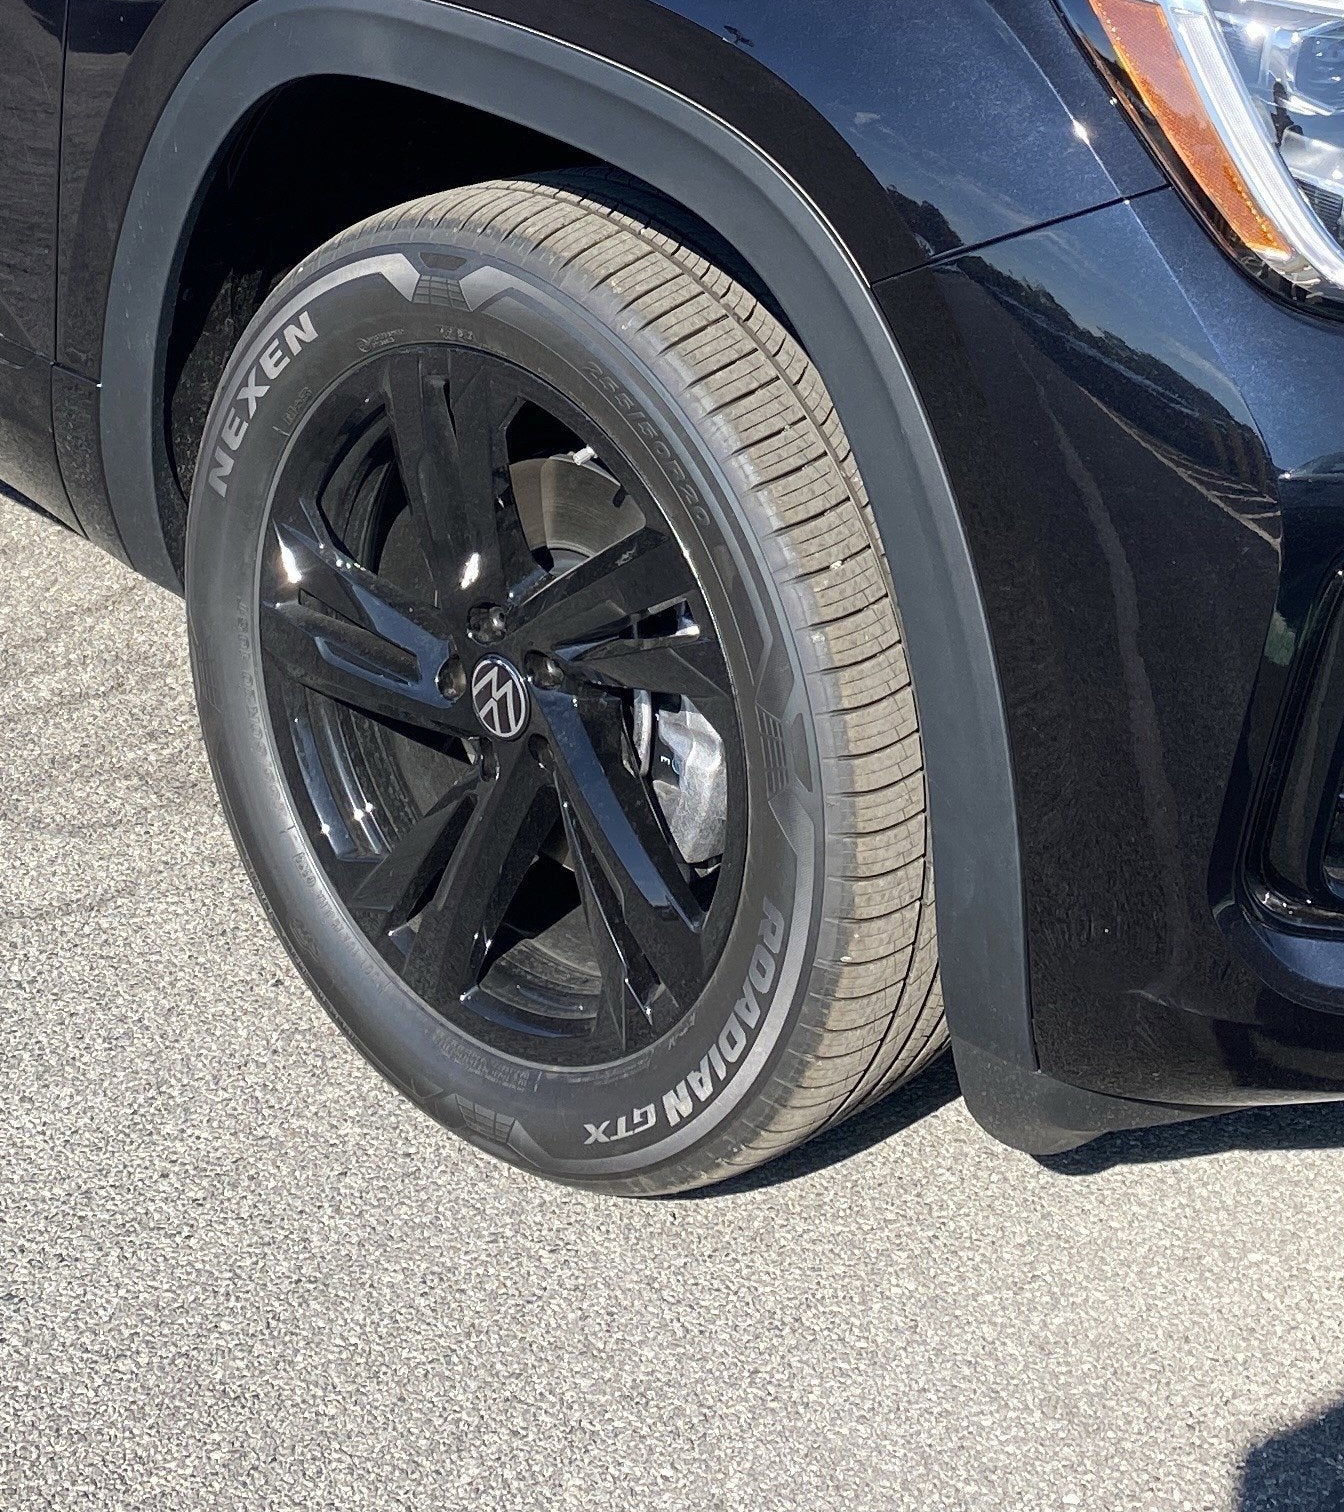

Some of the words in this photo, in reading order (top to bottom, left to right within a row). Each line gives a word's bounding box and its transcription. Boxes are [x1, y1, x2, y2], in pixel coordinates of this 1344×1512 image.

[208, 310, 319, 498] NEXEN
[662, 897, 785, 1128] ROADIAN
[583, 1103, 656, 1145] GTX
